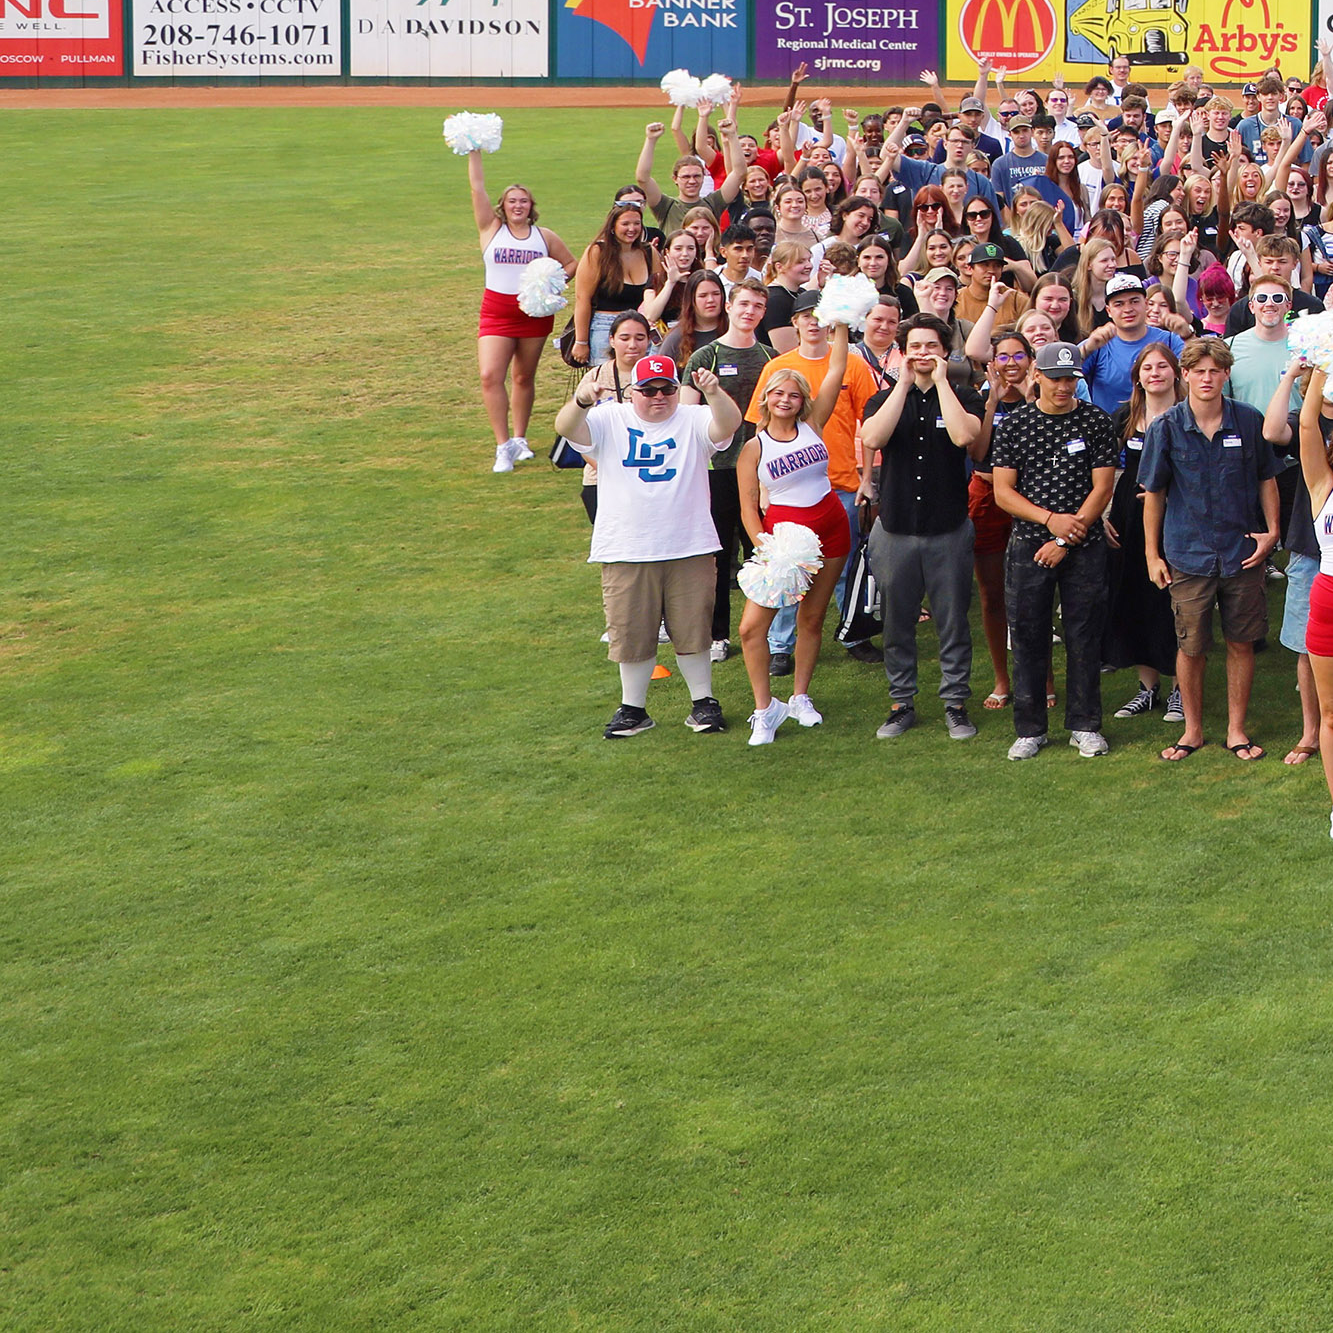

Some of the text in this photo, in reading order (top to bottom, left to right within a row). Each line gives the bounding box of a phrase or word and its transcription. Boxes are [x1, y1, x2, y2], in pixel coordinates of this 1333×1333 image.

[260, 0, 324, 13] CCTV
[663, 12, 738, 28] BANK
[775, 1, 919, 35] ST. JOSEPH
[143, 24, 331, 46] 208-746-1071
[406, 19, 541, 36] DAVIDSON
[776, 38, 918, 51] Regional Medical Center
[1193, 22, 1298, 61] Arby's
[61, 55, 115, 63] PULLMAN
[141, 49, 334, 68] FisherSystems.com
[814, 57, 881, 72] sjrmc.org
[650, 360, 662, 373] LC
[622, 427, 677, 482] LC
